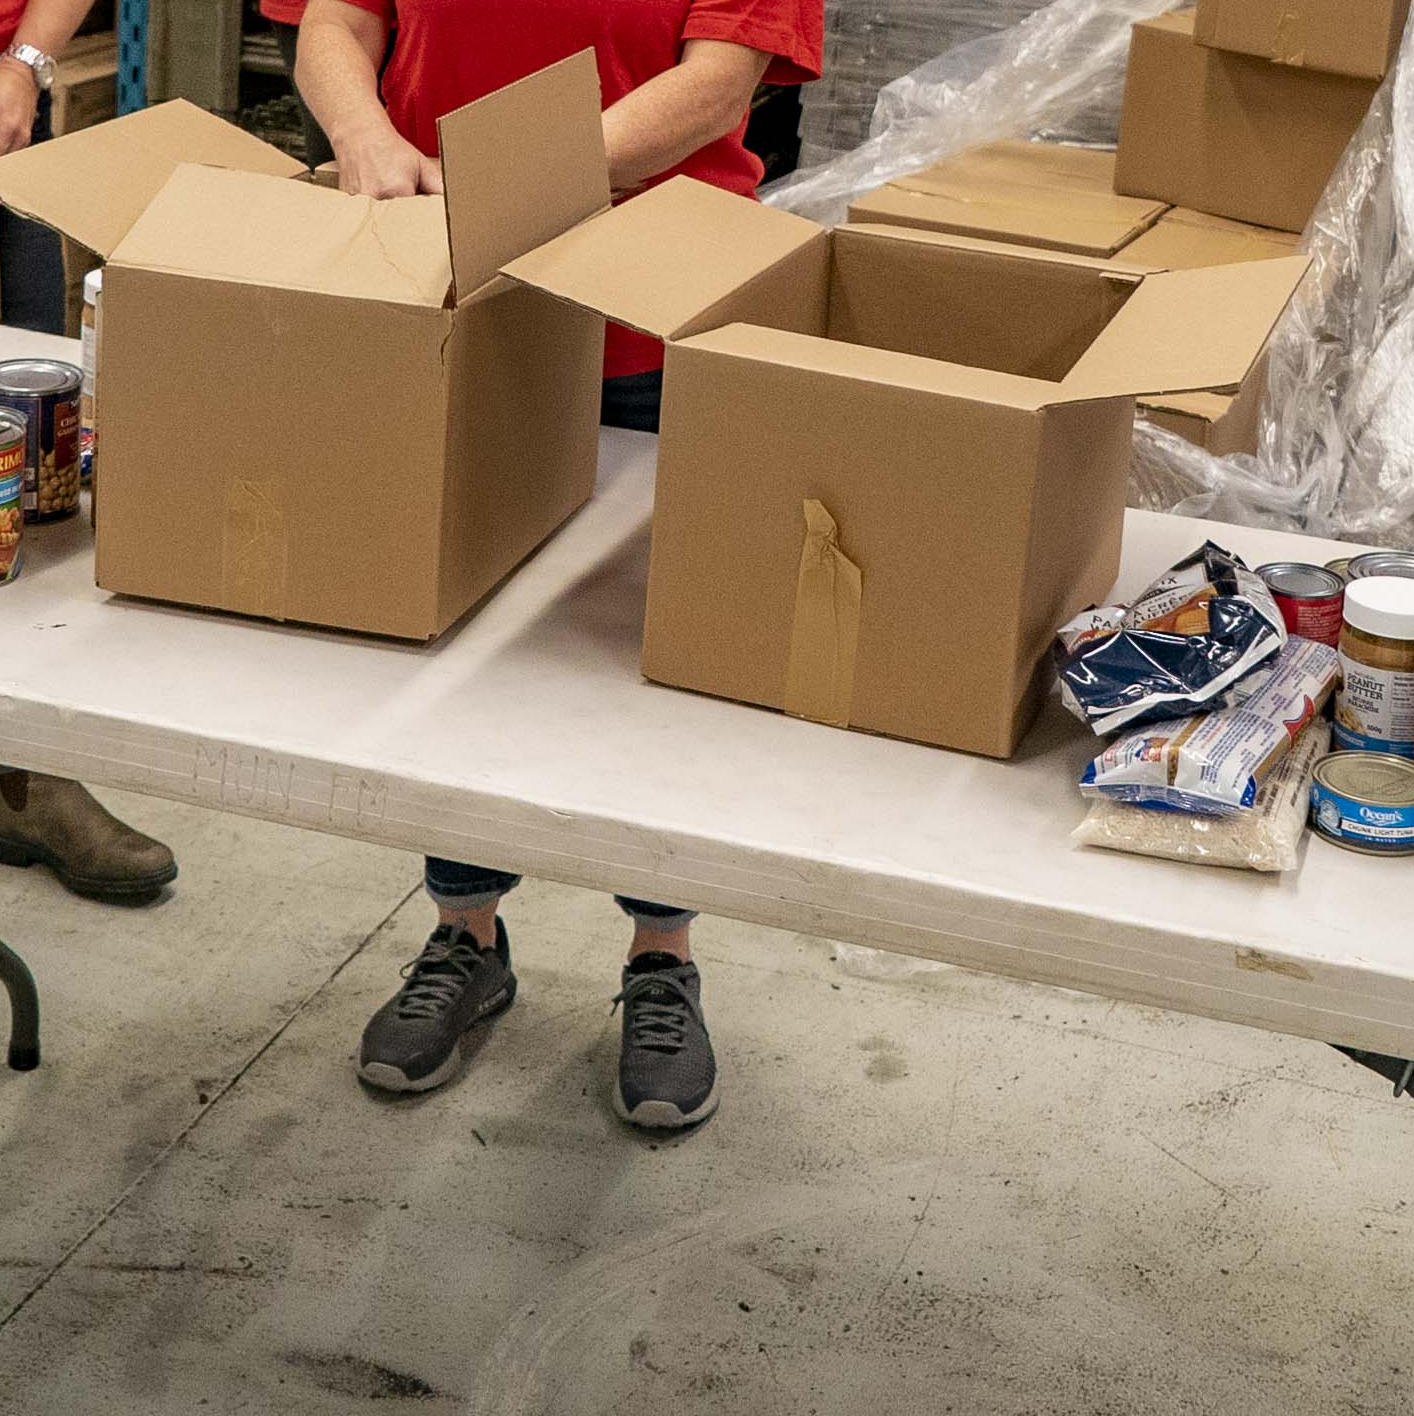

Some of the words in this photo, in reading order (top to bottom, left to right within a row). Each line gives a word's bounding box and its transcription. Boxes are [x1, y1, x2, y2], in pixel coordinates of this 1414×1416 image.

[1347, 672, 1385, 692] PEANUT
[1347, 681, 1383, 701] BUTTER
[1359, 807, 1404, 824] Ocean's
